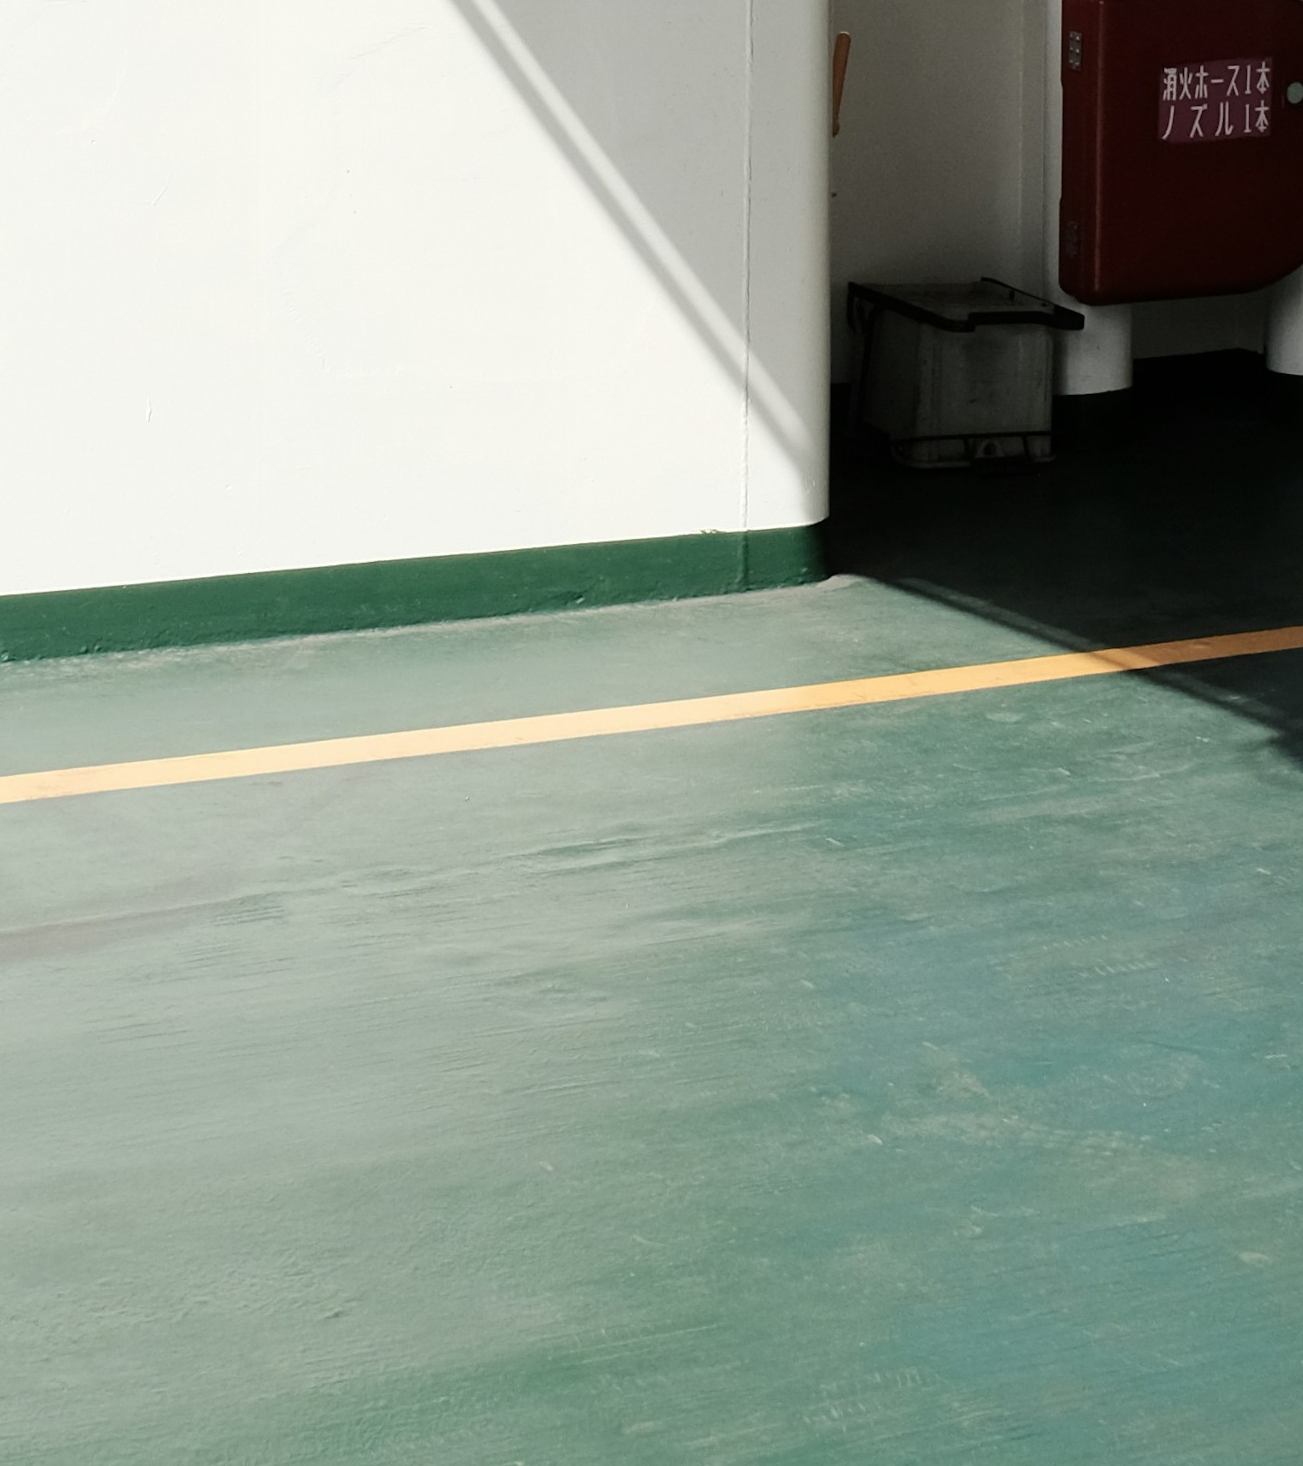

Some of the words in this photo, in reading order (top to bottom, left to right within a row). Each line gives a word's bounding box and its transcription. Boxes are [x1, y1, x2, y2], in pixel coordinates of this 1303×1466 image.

[1162, 61, 1271, 101] 消火ホース1本
[1161, 100, 1269, 140] ノズル1本
